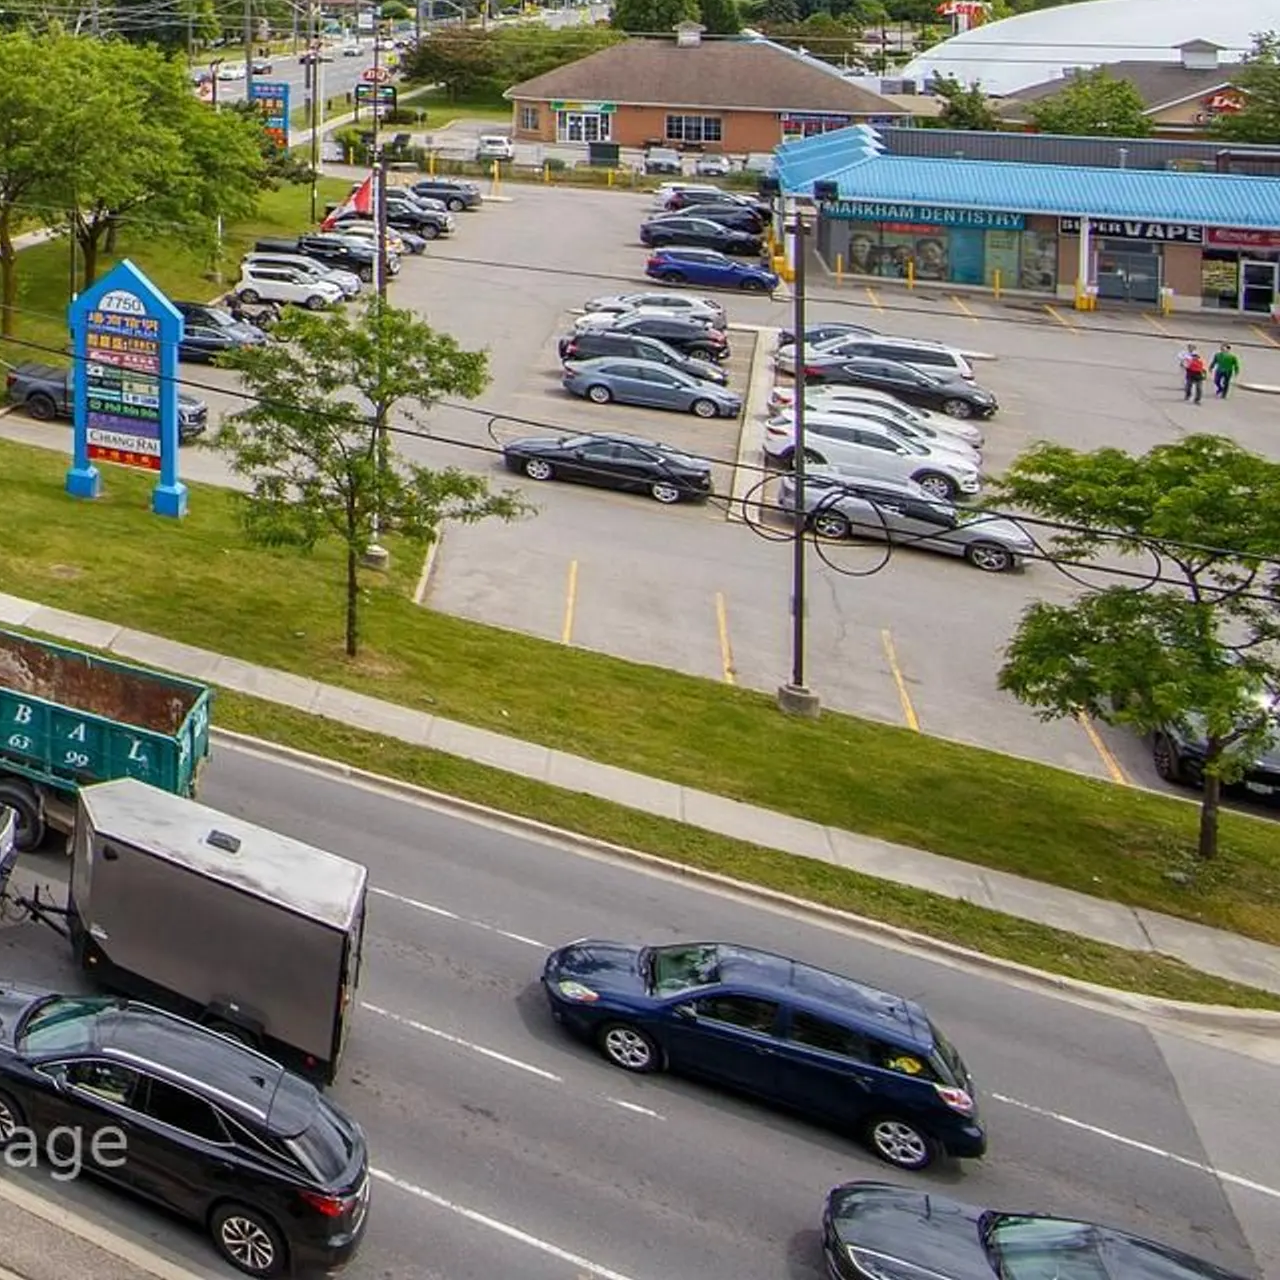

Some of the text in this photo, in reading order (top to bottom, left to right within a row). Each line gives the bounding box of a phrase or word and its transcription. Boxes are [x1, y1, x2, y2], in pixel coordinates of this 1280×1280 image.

[823, 202, 1022, 225] MARKHAM DENTISTRY
[1125, 221, 1201, 241] VAPE
[105, 296, 141, 311] 7750
[8, 734, 32, 749] 63
[64, 751, 89, 767] 99
